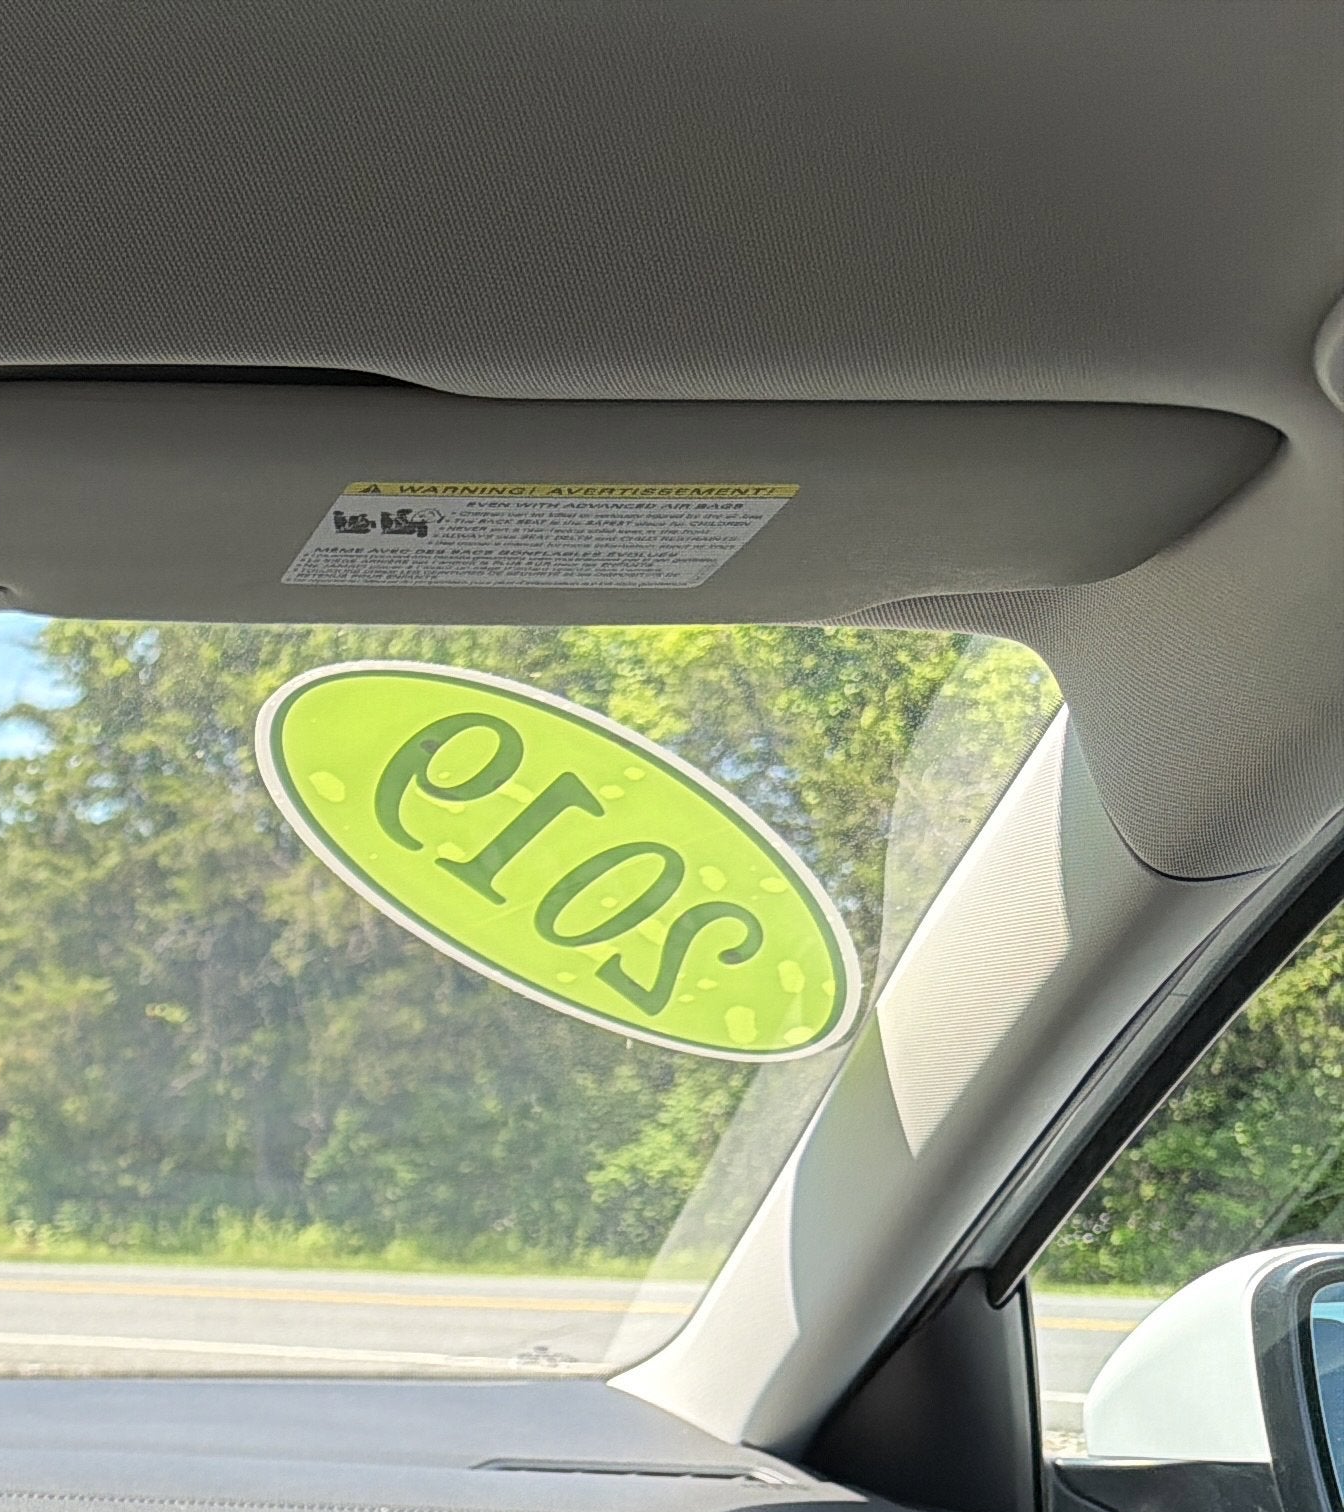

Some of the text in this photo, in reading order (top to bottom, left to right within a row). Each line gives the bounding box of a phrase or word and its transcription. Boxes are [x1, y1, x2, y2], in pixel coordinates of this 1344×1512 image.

[399, 485, 776, 496] WARNING! AVERTISSEMENT!
[466, 501, 509, 509] EVEN
[562, 502, 656, 510] ADVANCED
